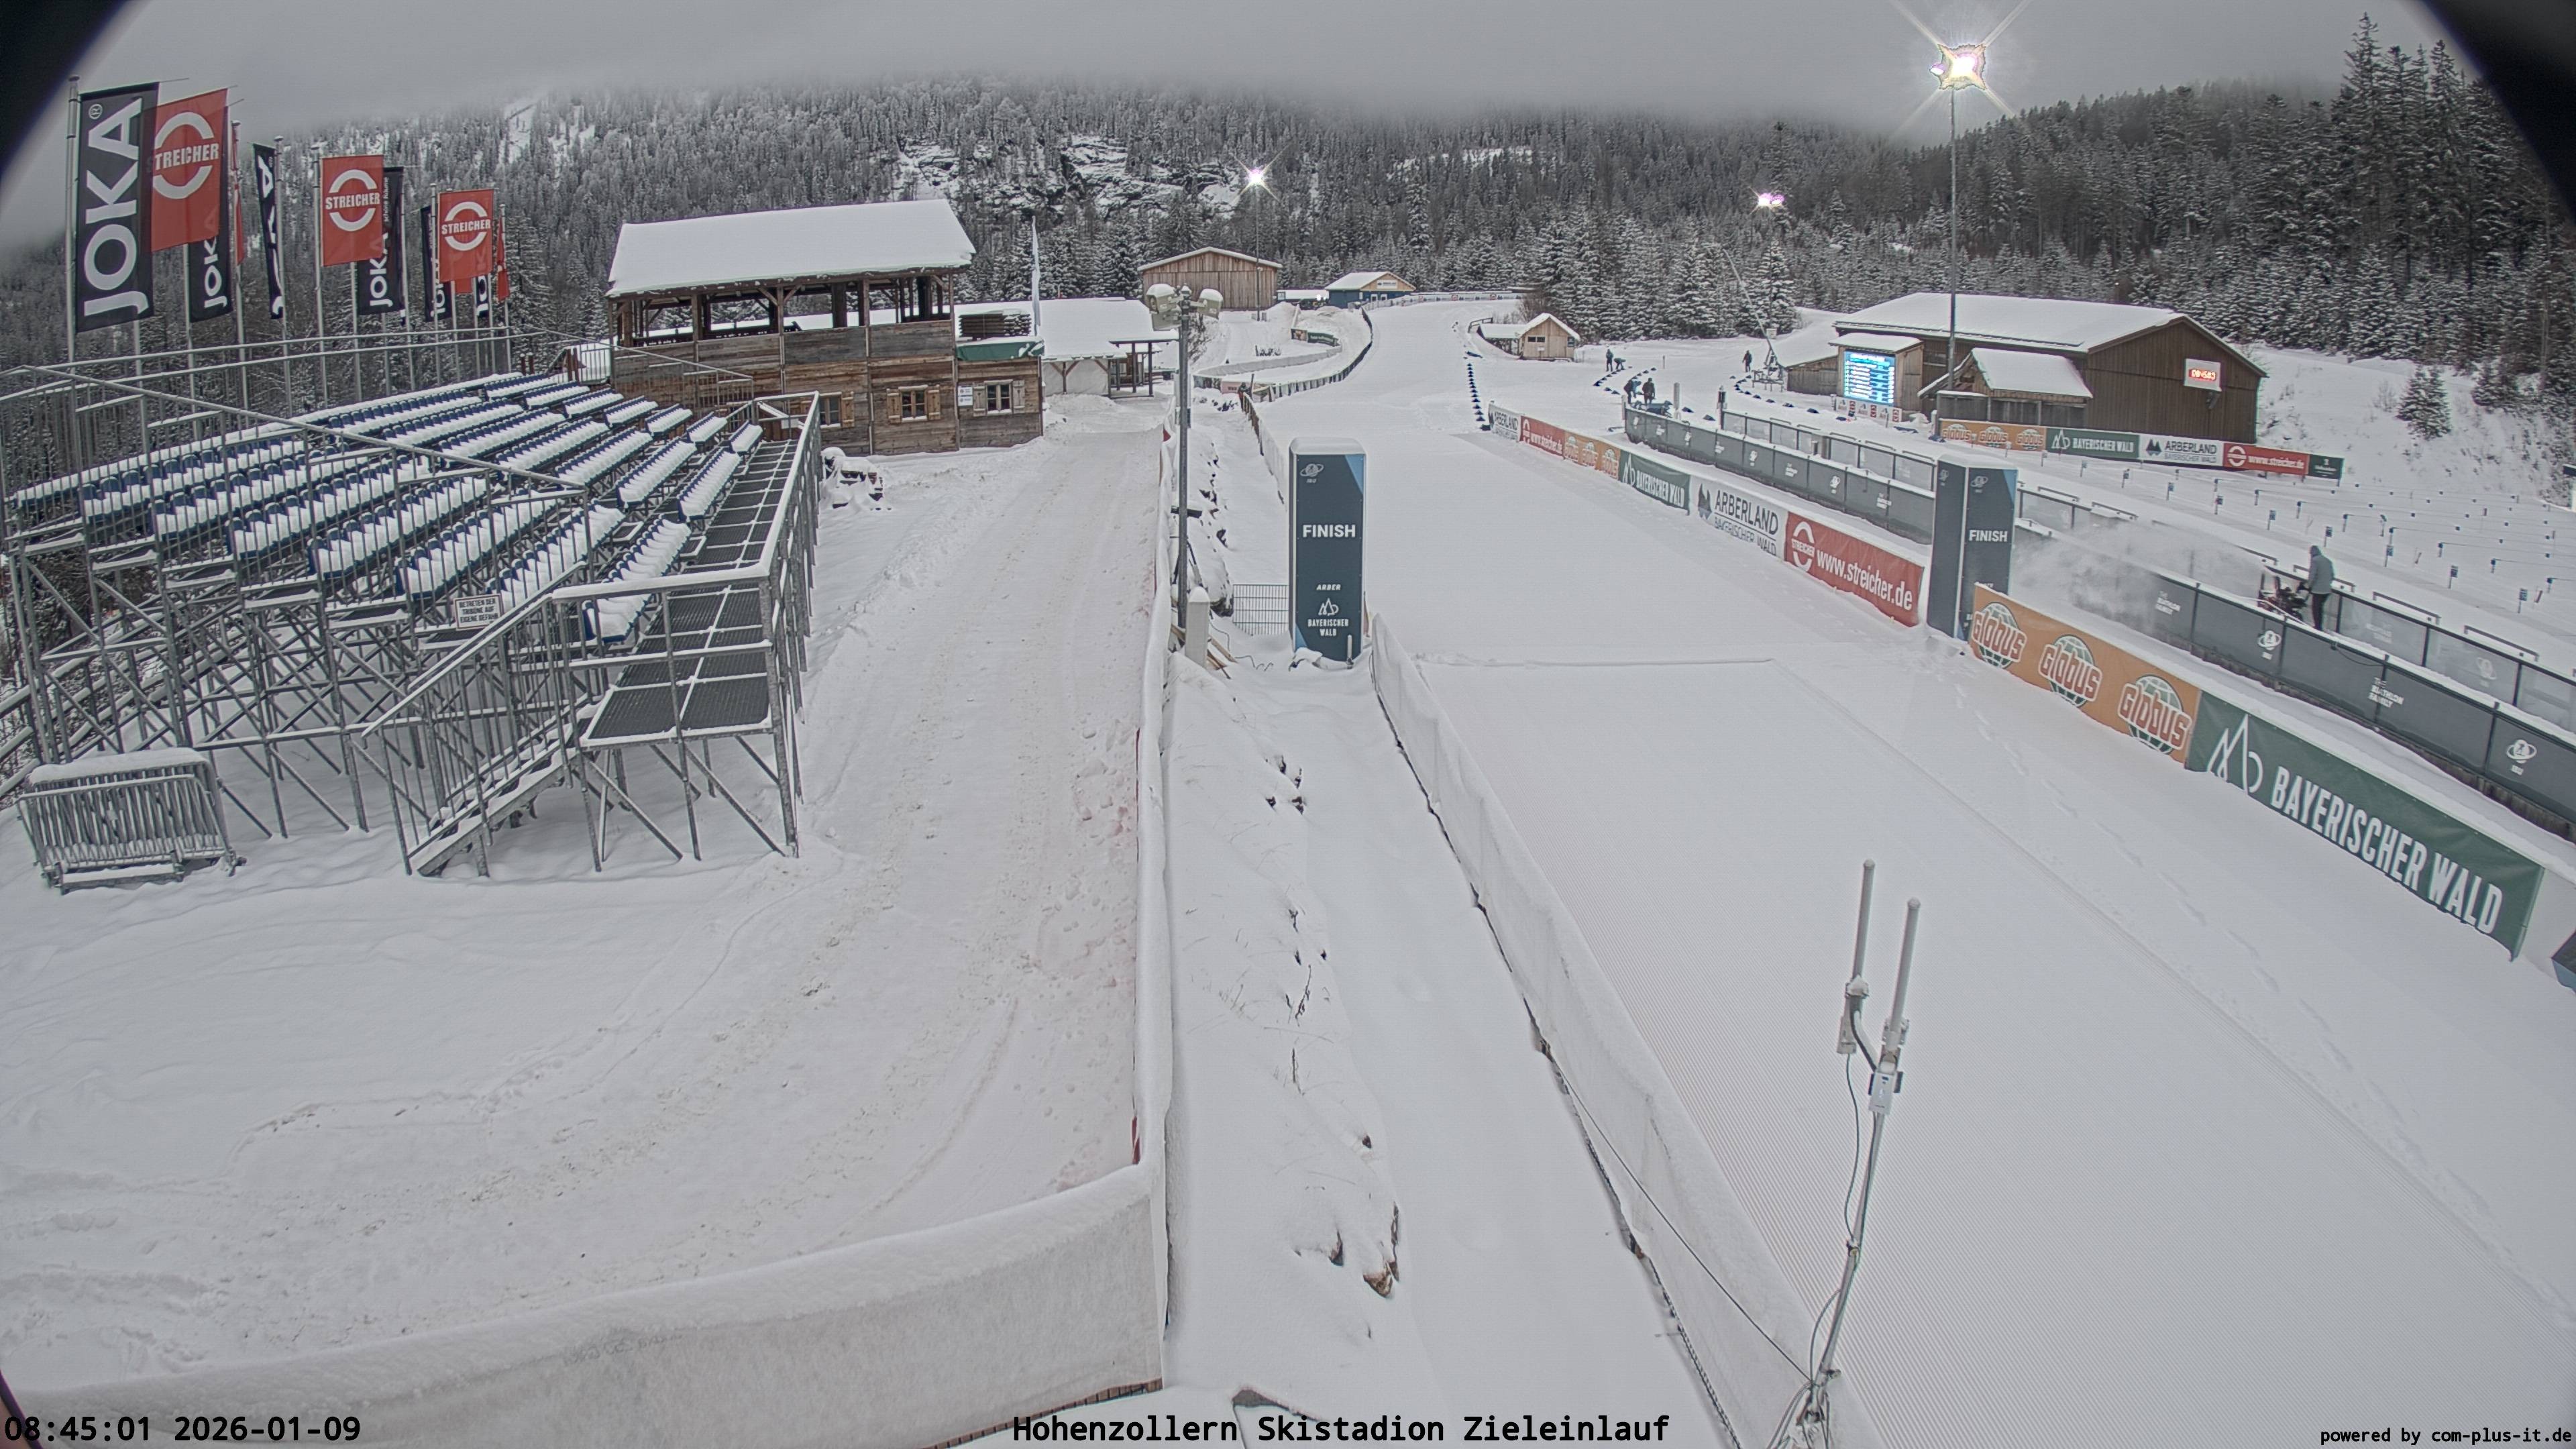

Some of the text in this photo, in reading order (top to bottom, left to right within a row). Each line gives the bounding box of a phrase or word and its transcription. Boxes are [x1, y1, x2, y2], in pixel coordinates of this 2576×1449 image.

[325, 193, 380, 210] STREICHER
[441, 219, 491, 235] STREICHER
[2072, 437, 2134, 453] BAYERISCHER WALD
[2165, 440, 2218, 454] ARBERLAND
[1715, 490, 1778, 535] ARBERLAND
[1303, 524, 1356, 537] FINISH
[1968, 529, 2008, 542] FINISH
[1817, 550, 1913, 610] www.streicher.de
[1307, 619, 1349, 627] BAYERISCHER
[1320, 628, 1337, 637] WALD
[2039, 643, 2102, 702] Globus
[2118, 682, 2192, 750] Globus
[2270, 765, 2503, 934] BAYERISCHER WALD
